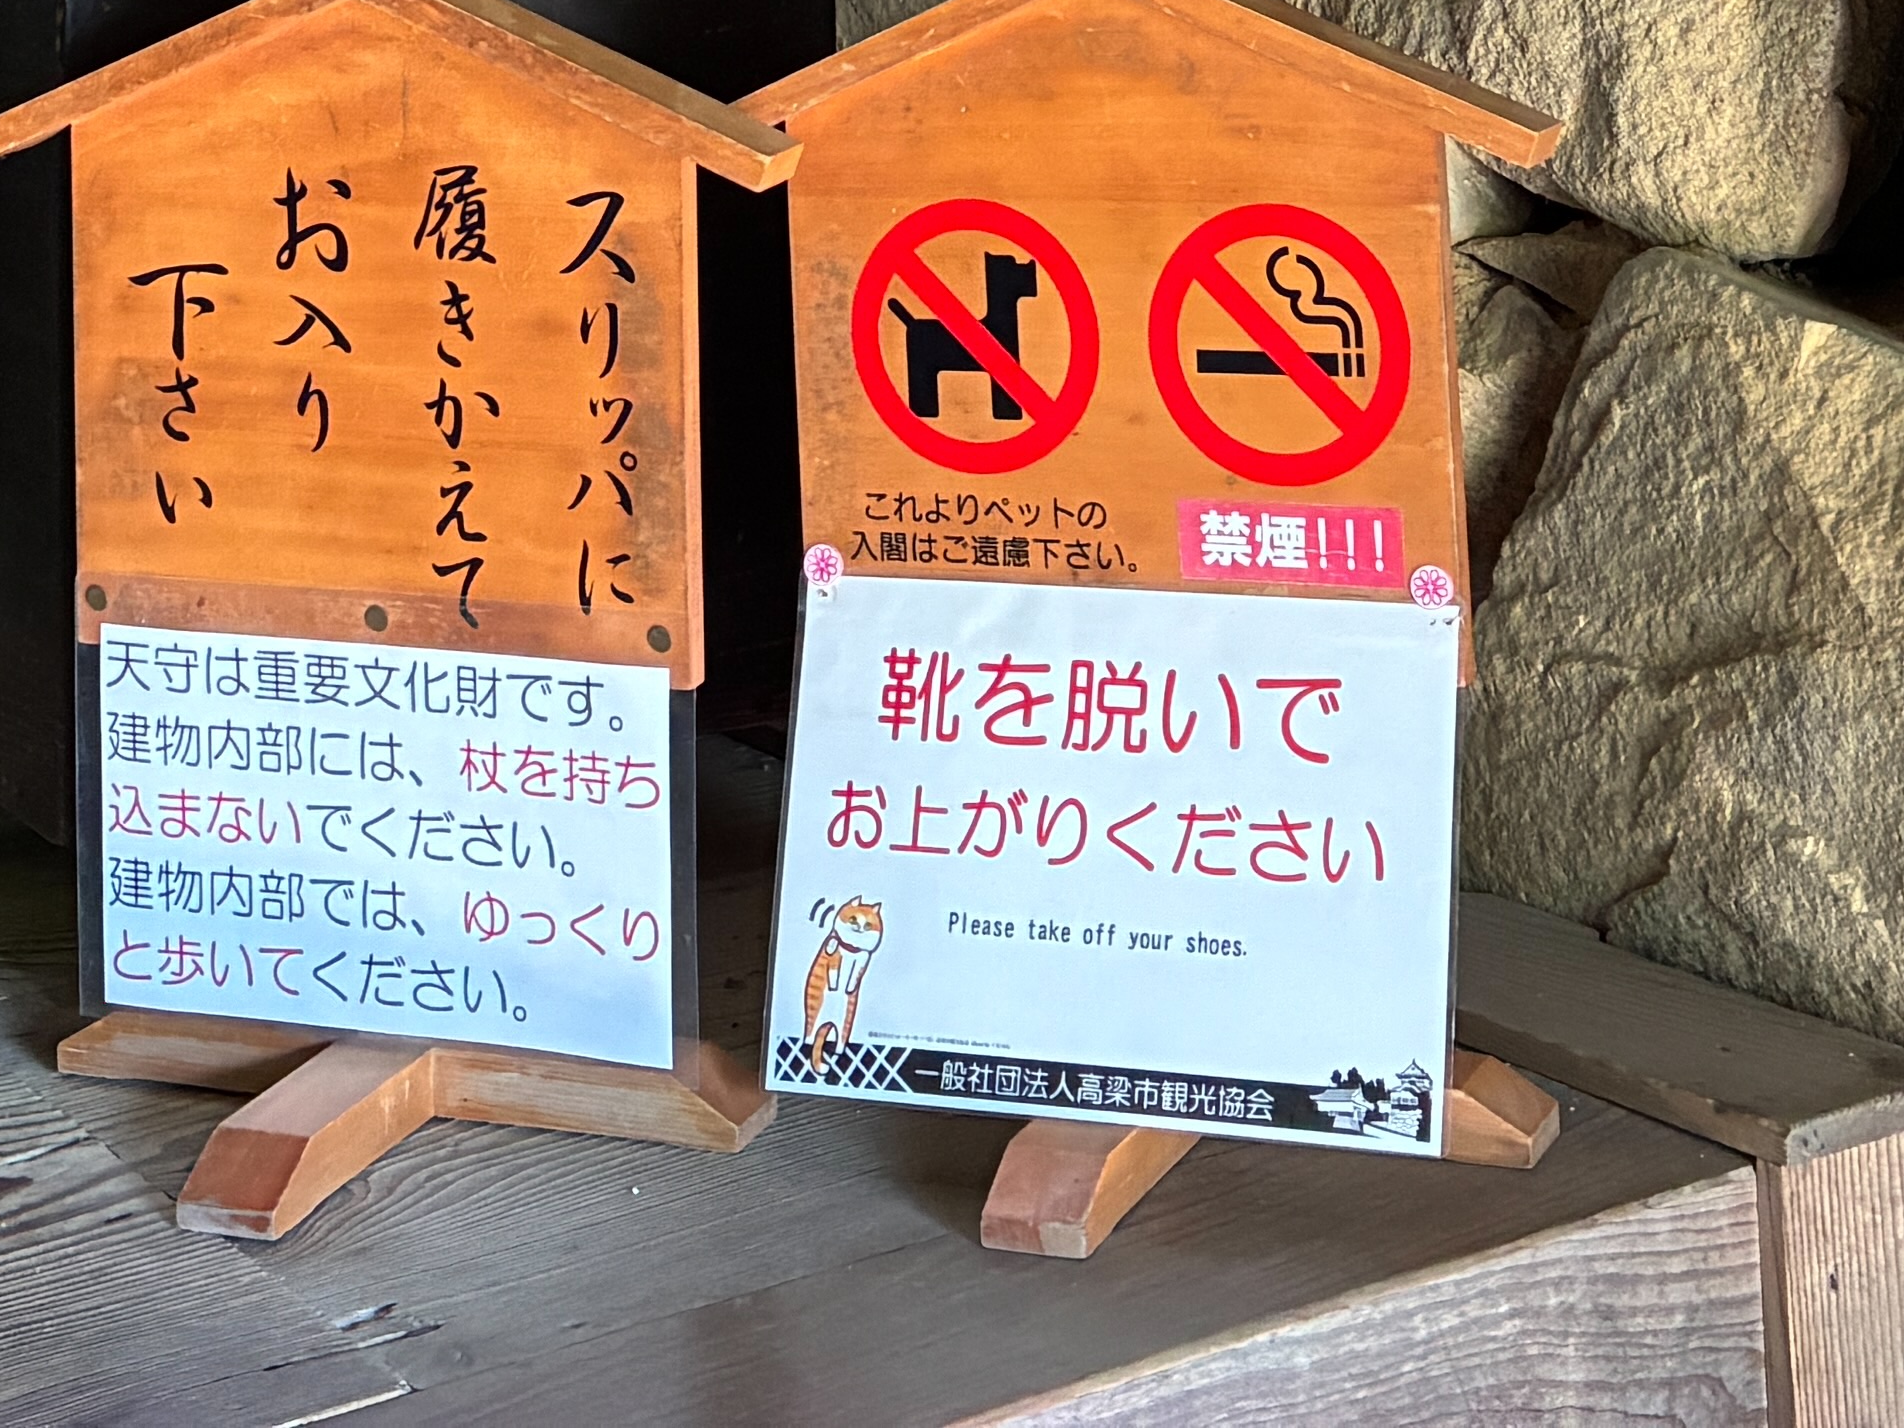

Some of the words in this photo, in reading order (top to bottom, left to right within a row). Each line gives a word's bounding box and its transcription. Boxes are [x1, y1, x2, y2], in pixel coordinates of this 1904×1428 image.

[273, 165, 352, 454] お入り
[127, 262, 230, 524] 下さい
[413, 165, 500, 630] 履きかえて
[559, 189, 638, 616] スリッパに
[864, 490, 1108, 529] これよりペットの
[104, 639, 624, 734] 天守は重要文化財です。
[877, 646, 1344, 765] 靴を脱いで
[106, 710, 663, 810] 建物内部には、杖を持ち
[107, 782, 577, 878] 込まないでください。
[826, 779, 1386, 884] お上がりください
[107, 855, 662, 962] 建物内部では、ゆっくり
[947, 911, 1015, 939] Please
[1028, 918, 1072, 943] take
[1082, 922, 1117, 947] off
[1127, 930, 1174, 951] your
[1185, 930, 1248, 958] shoes.
[111, 929, 529, 1024] と歩いてください。
[914, 1058, 1275, 1122] 一般社団法人高梁市観光協会
